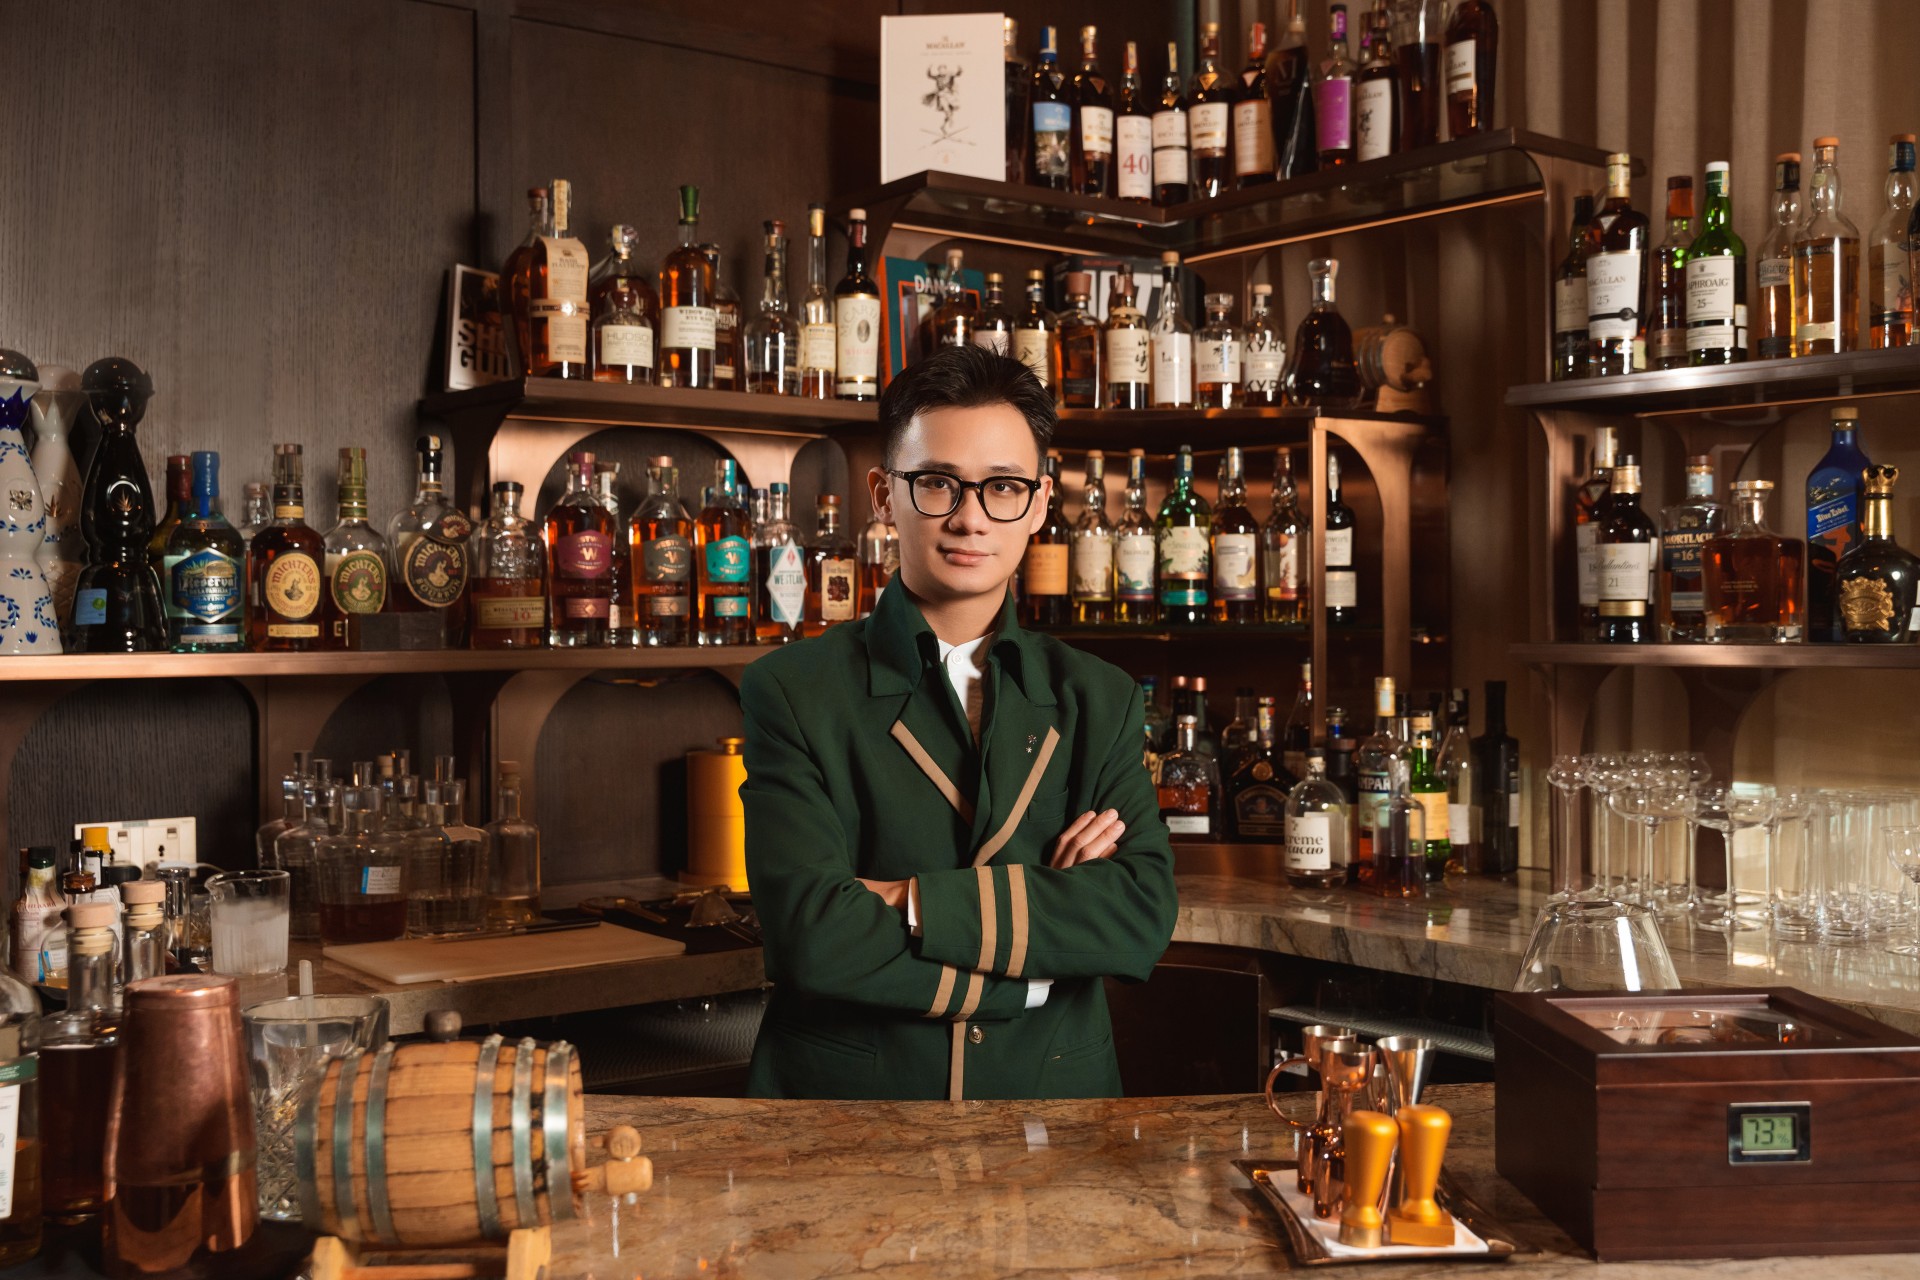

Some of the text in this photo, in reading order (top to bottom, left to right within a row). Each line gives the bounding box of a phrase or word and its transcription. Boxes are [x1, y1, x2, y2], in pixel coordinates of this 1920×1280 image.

[1123, 153, 1150, 175] 40
[1687, 278, 1729, 290] APHROAIG
[1696, 298, 1707, 309] 25
[607, 332, 649, 342] HUDSO
[1682, 549, 1694, 561] 16
[1608, 577, 1619, 588] 21
[513, 611, 531, 622] 10
[1360, 776, 1392, 791] MPAR
[1747, 1119, 1774, 1145] 73
